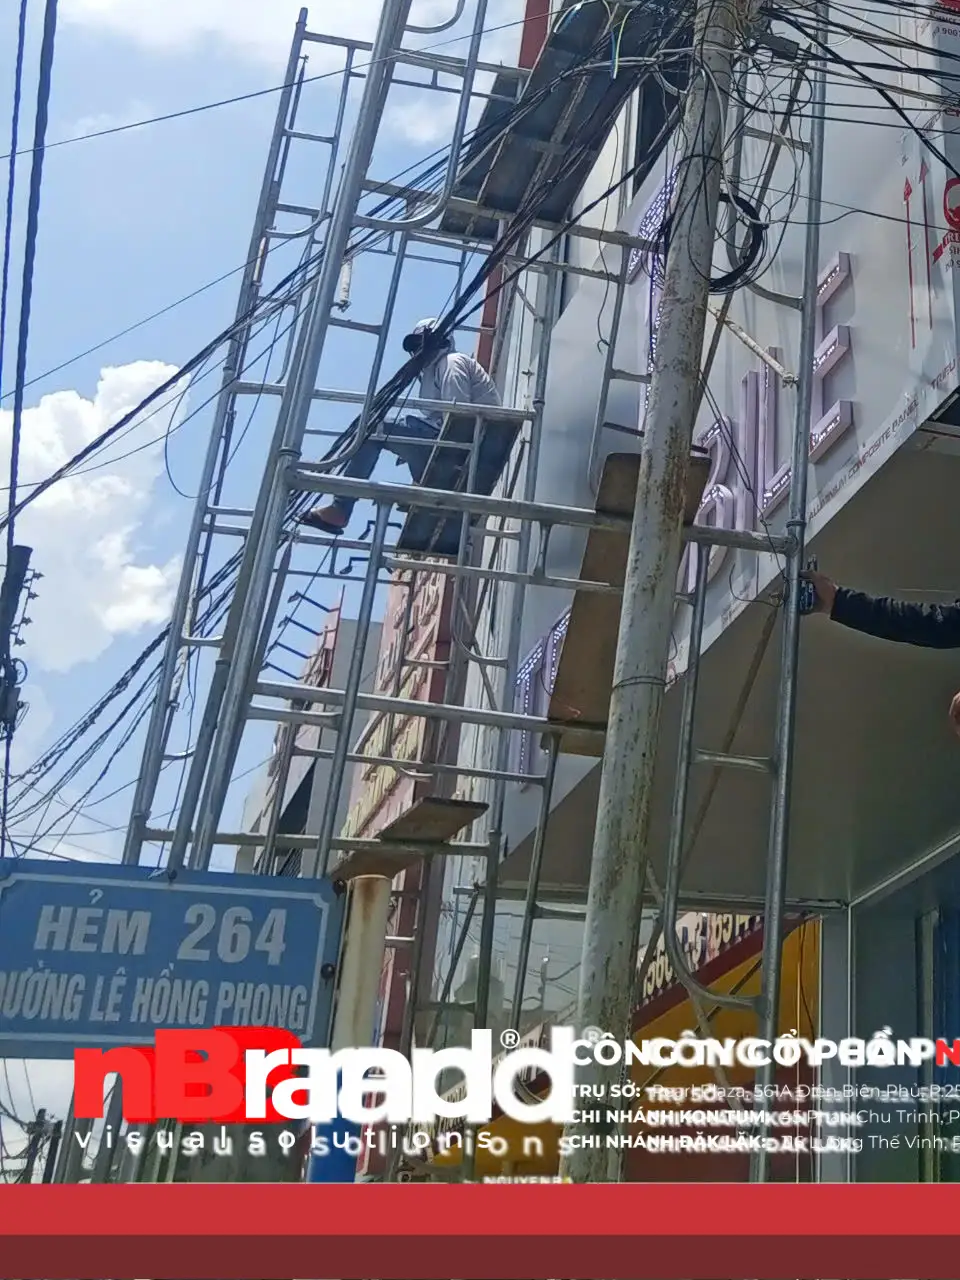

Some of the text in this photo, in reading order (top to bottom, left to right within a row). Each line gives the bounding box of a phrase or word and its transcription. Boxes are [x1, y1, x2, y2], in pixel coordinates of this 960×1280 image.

[34, 888, 288, 966] HẺM 264
[88, 966, 127, 1022] LÊ
[130, 962, 208, 1025] HỒNG
[214, 981, 307, 1032] PHONG
